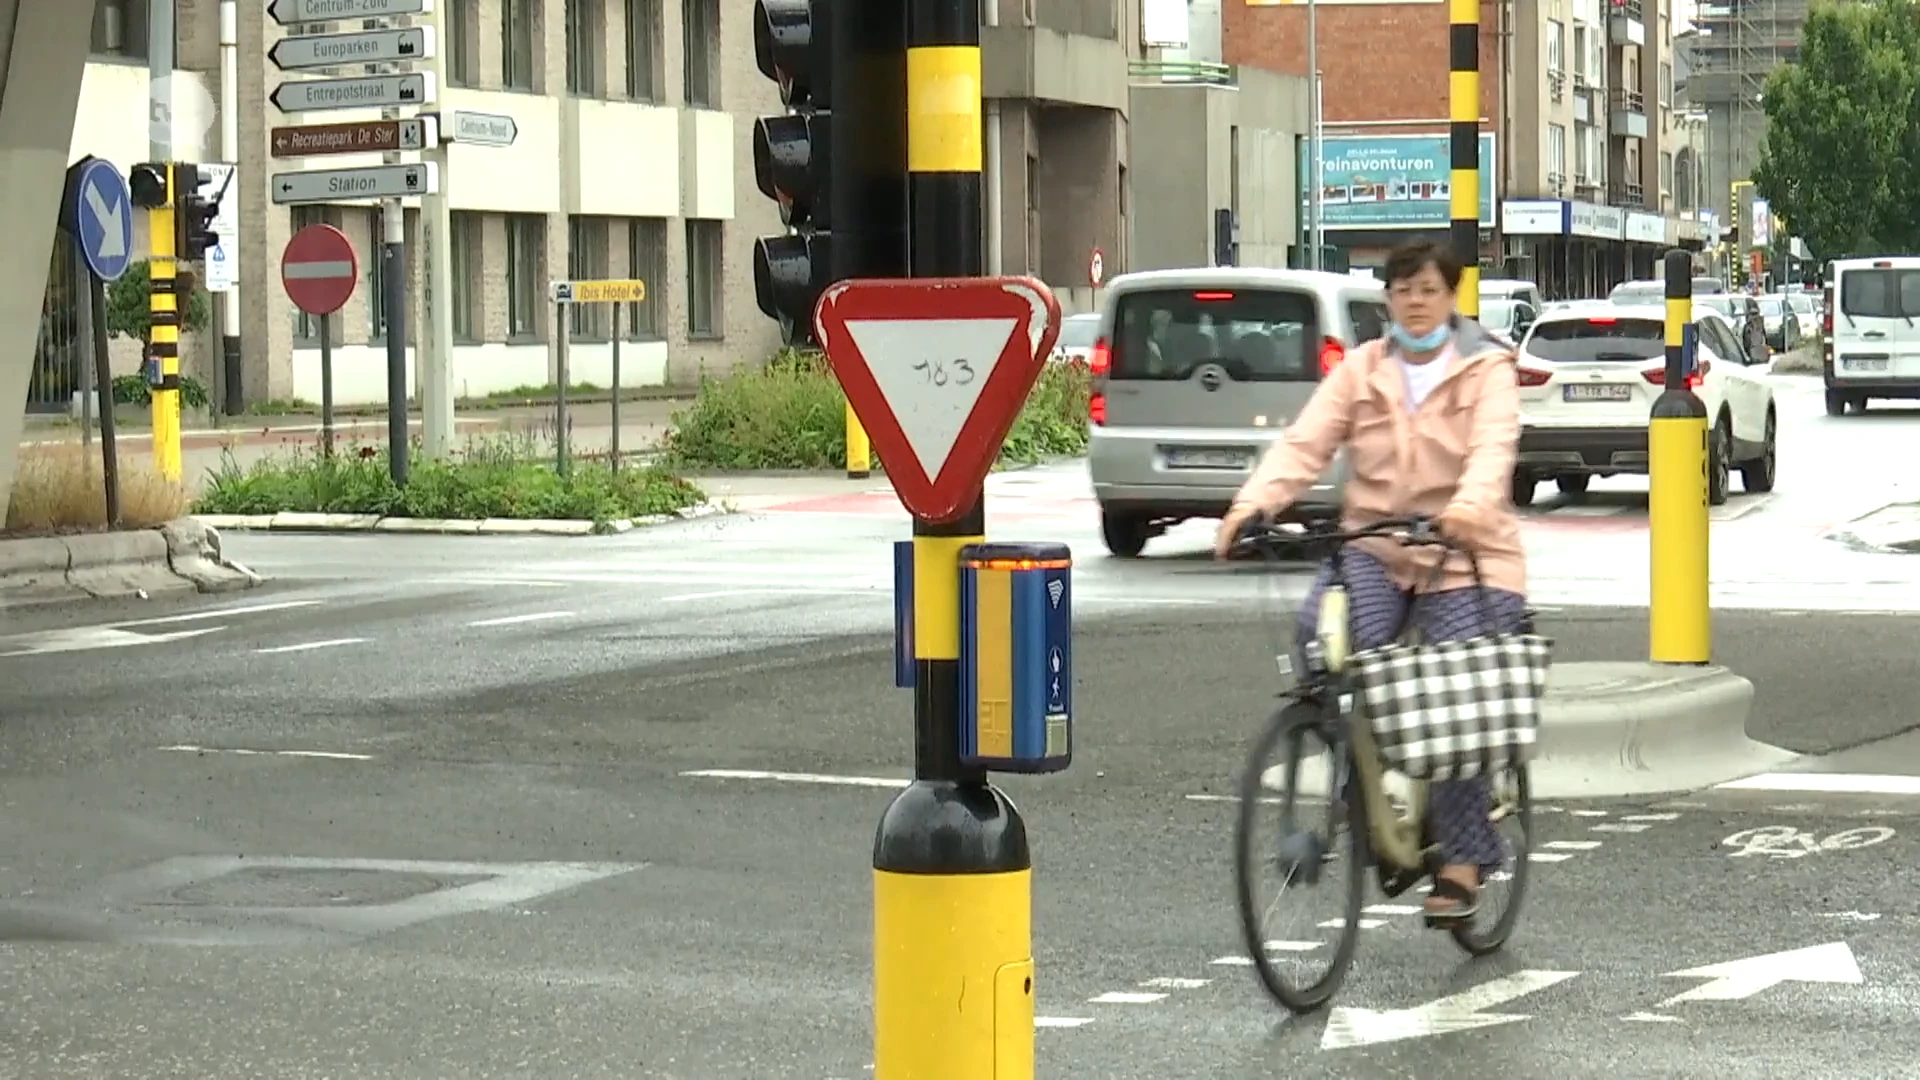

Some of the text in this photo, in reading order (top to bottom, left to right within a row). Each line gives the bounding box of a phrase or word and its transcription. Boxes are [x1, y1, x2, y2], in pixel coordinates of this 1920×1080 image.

[305, 0, 388, 13] Centrum-Zuid
[313, 40, 379, 58] Europarken
[306, 84, 385, 102] Entrepotstraat
[291, 127, 395, 148] Recreatiepark De Ster
[328, 176, 377, 193] Station
[580, 284, 631, 299] Ibis Hotel
